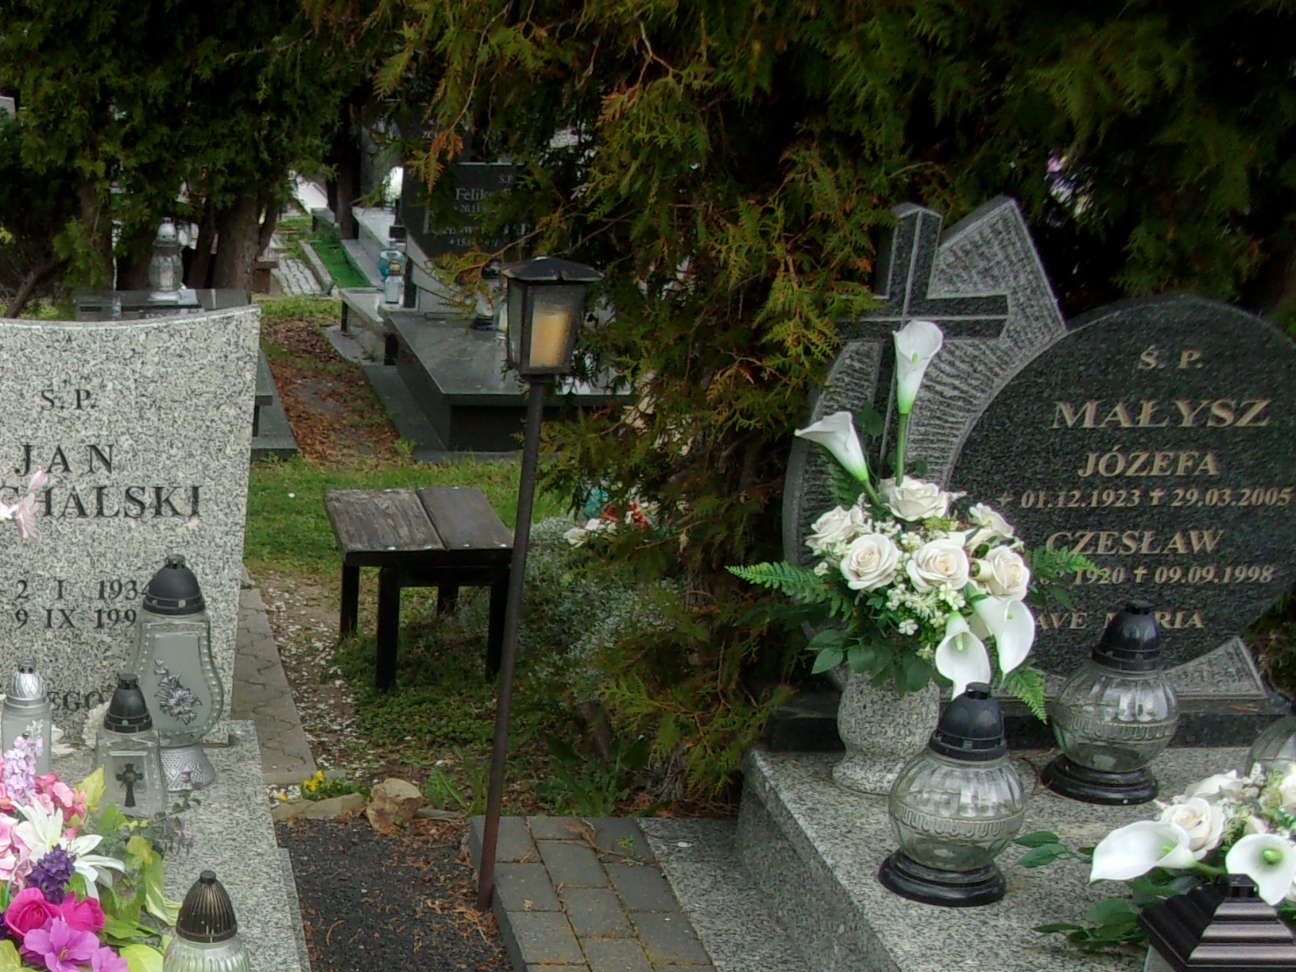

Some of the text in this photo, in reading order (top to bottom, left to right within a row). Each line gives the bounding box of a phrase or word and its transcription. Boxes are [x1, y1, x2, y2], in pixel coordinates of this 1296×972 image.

[1137, 345, 1204, 370] Ś. P.
[1050, 399, 1273, 429] MAŁYSZ
[15, 443, 115, 477] JAN
[1077, 445, 1220, 478] JÓZEFA
[1021, 487, 1294, 509] 01.12.1923 29.03.2005
[1044, 529, 1225, 556] CZESŁAW
[1153, 565, 1276, 584] 09.09.1998
[16, 580, 29, 600] 2
[15, 608, 137, 629] 9 IX 199
[1035, 612, 1088, 630] AVE
